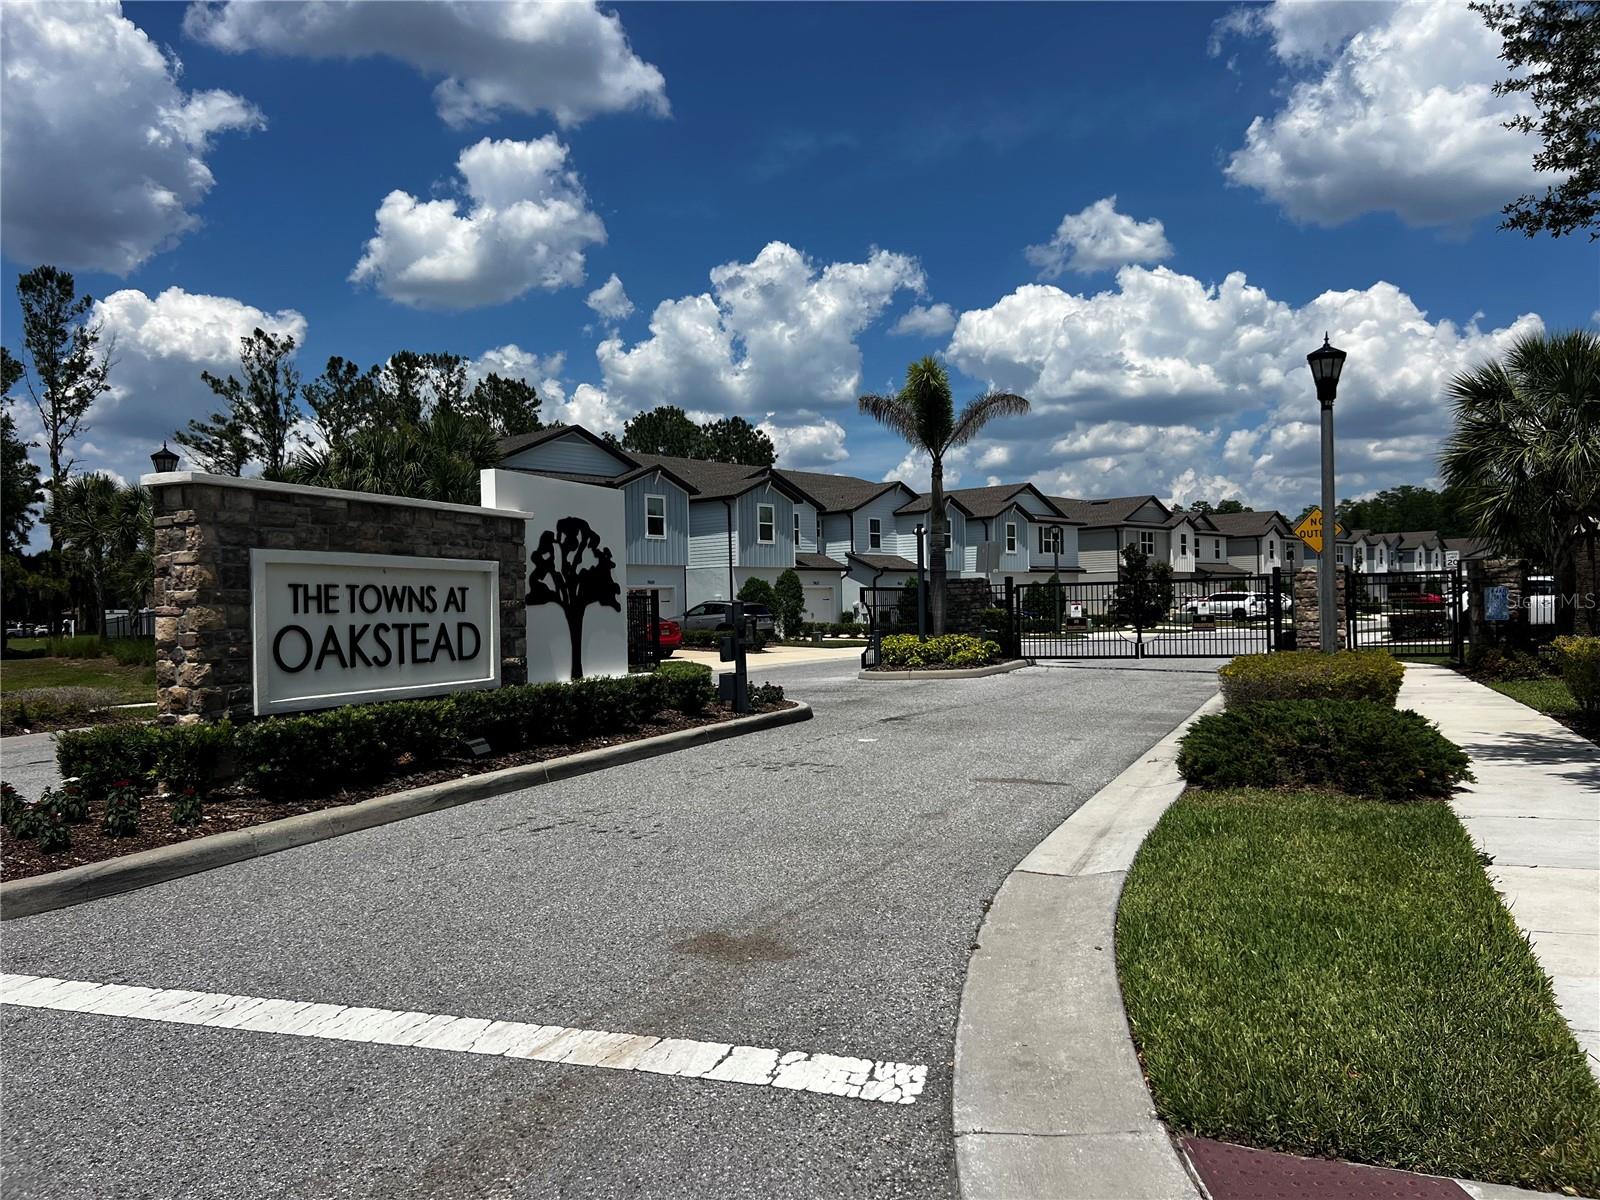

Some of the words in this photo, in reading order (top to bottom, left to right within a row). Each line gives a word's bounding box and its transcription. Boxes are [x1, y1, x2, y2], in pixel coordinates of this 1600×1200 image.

[1300, 530, 1323, 538] OUTL
[288, 583, 340, 614] THE
[345, 584, 437, 614] TOWNS
[443, 587, 470, 613] AT
[272, 622, 481, 673] OAKSTEAD
